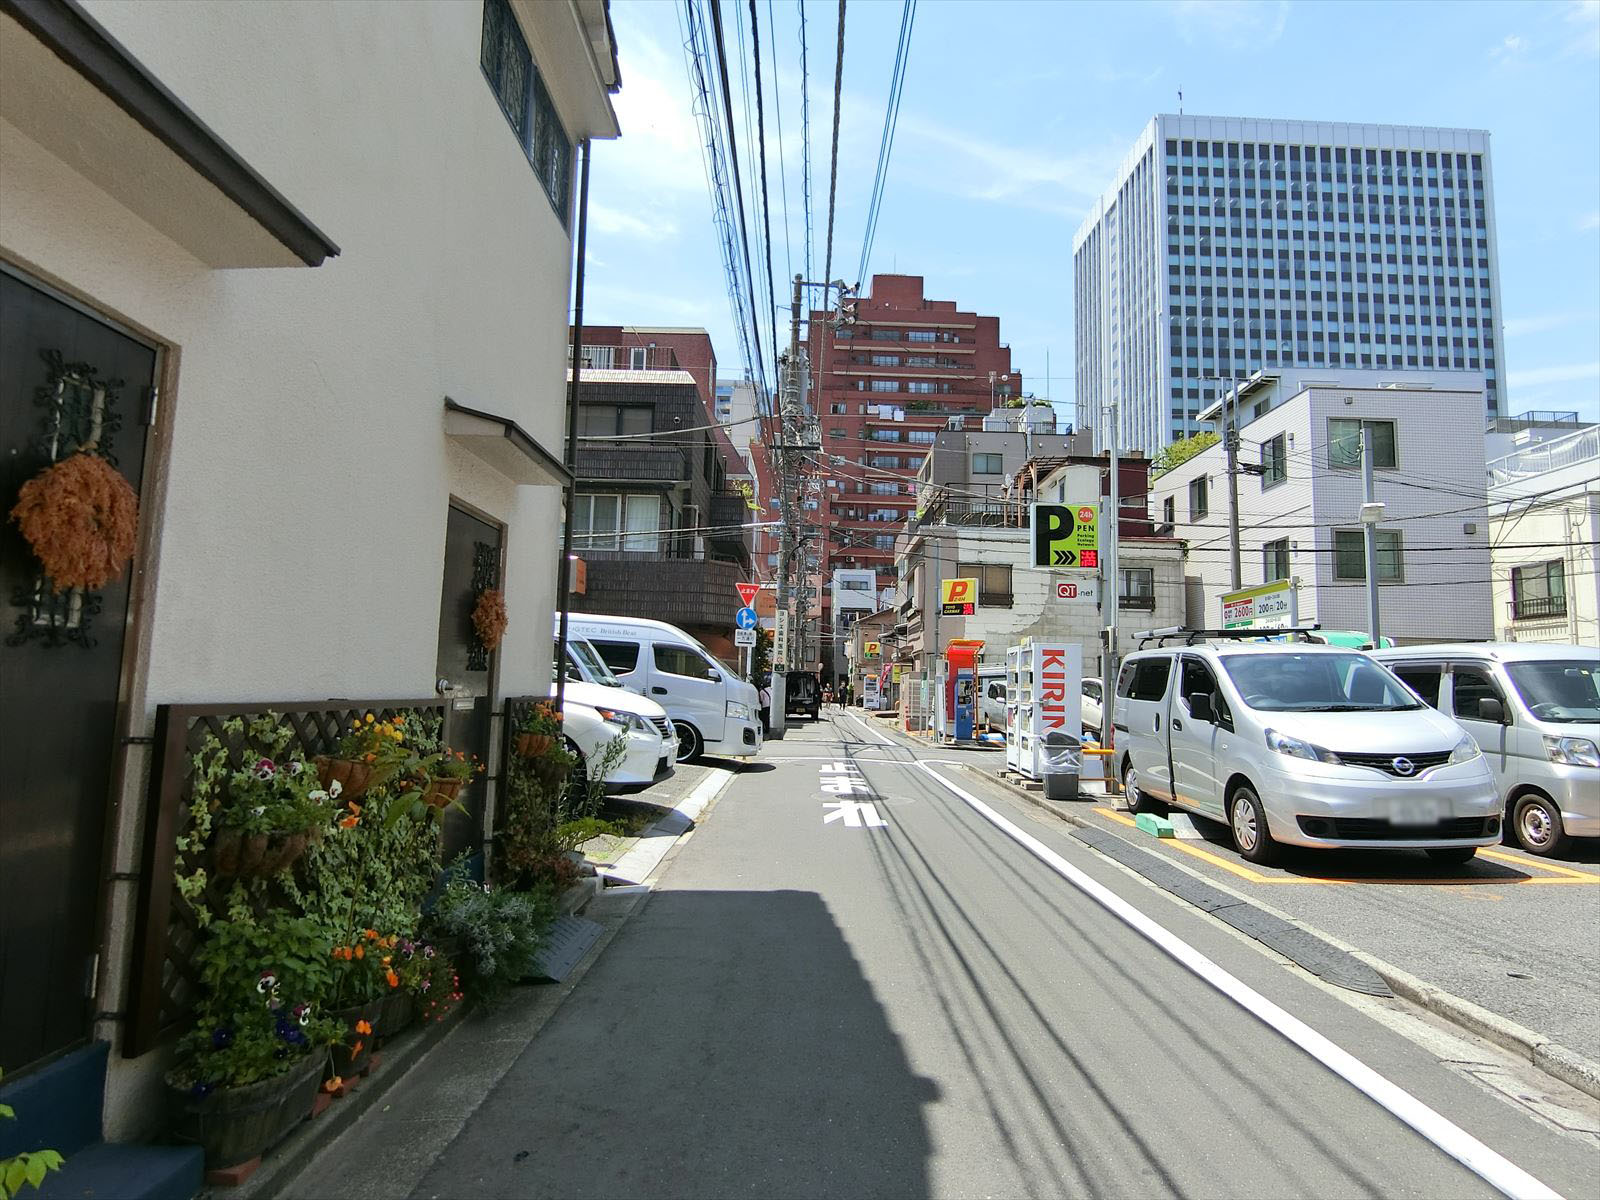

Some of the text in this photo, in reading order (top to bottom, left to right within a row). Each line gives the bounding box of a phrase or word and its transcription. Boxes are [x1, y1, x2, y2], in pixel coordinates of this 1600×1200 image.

[1079, 509, 1093, 518] 24h
[1036, 506, 1074, 565] P
[1081, 551, 1096, 566] 満
[948, 582, 968, 602] P
[1041, 649, 1066, 733] KIRIN
[819, 762, 888, 827] 止まれ
